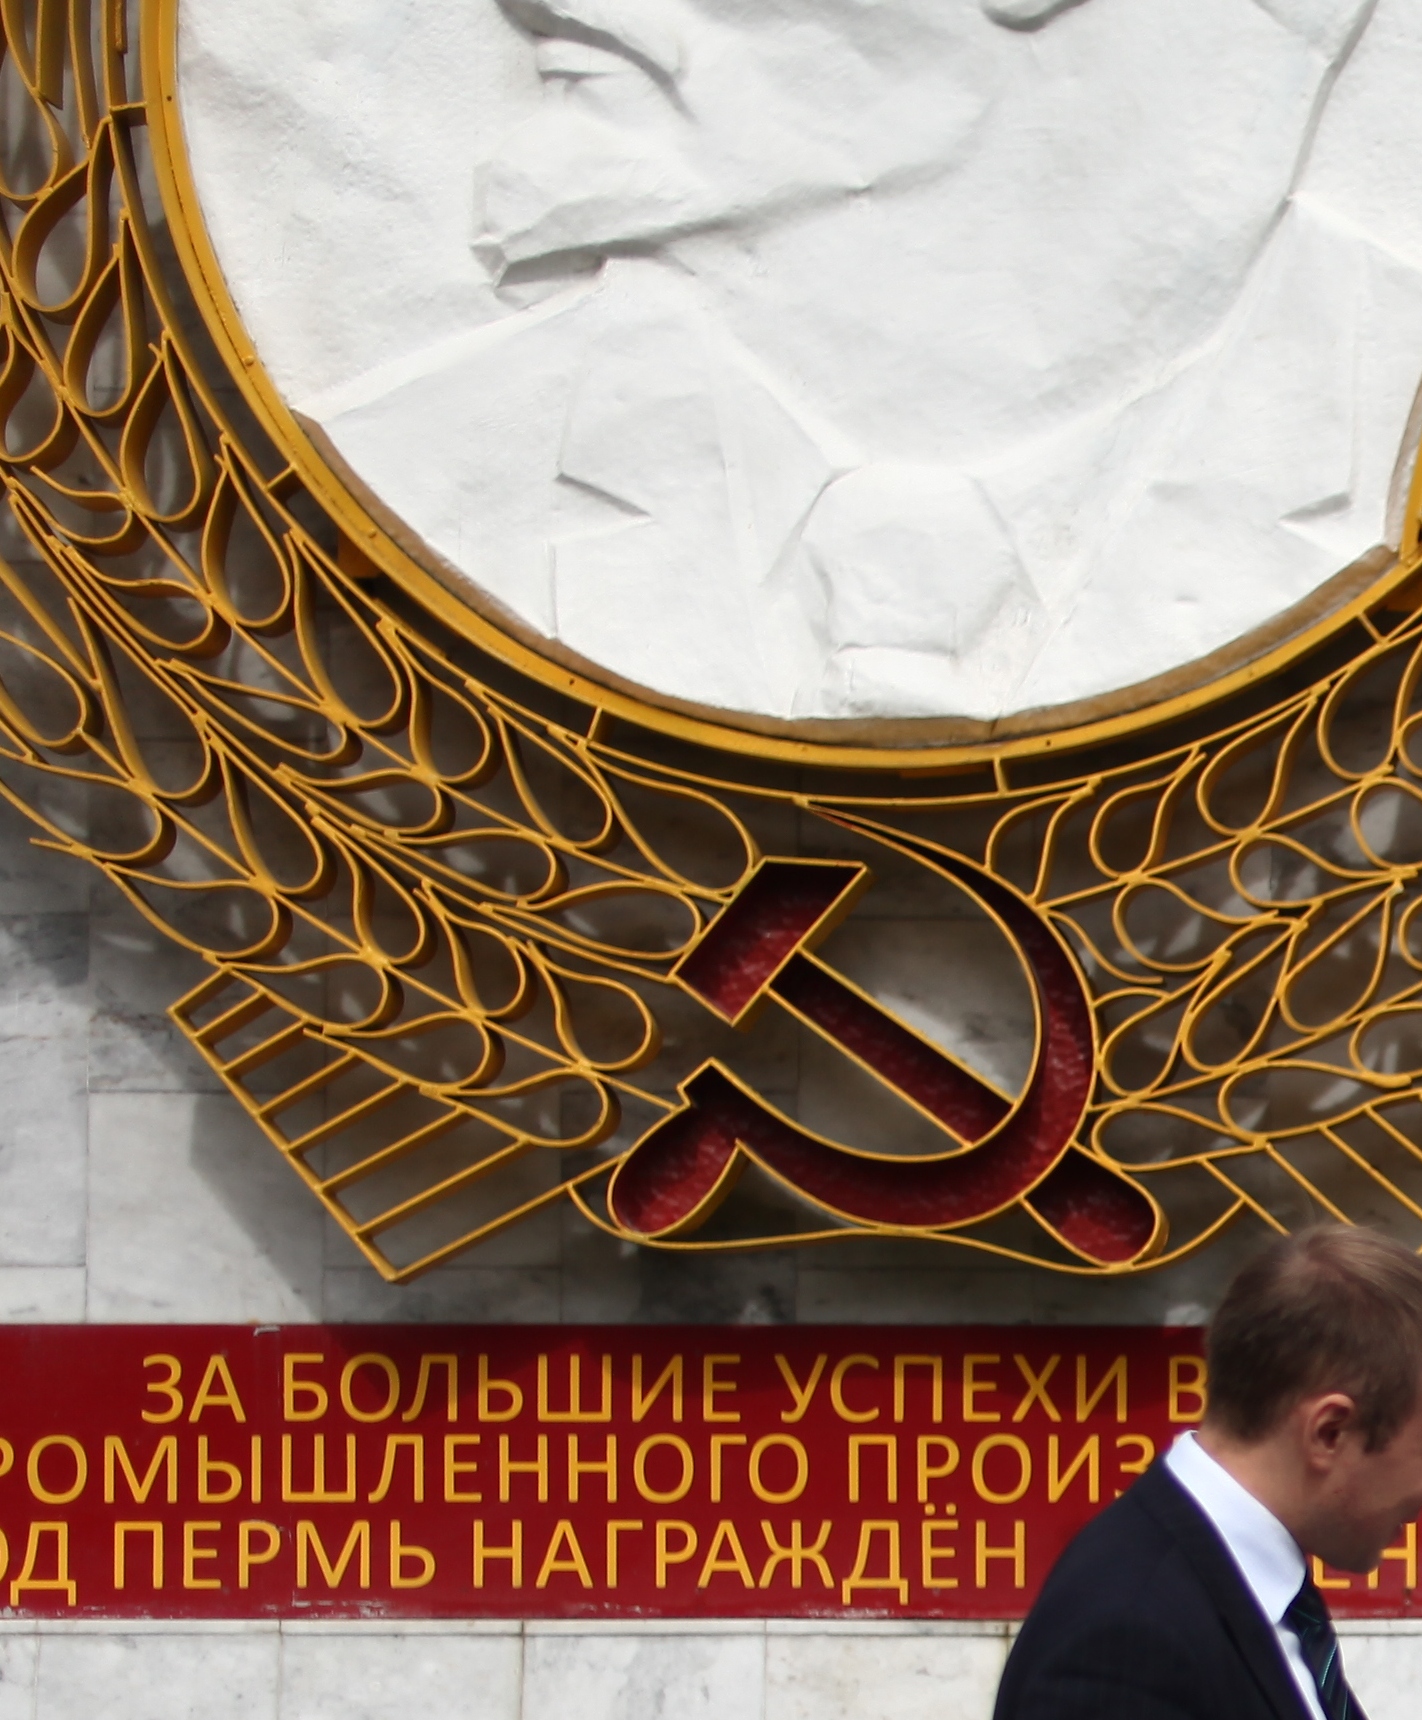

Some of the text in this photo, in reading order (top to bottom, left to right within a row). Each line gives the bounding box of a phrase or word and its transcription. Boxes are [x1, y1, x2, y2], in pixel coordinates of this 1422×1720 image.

[142, 1354, 247, 1423] ЗА
[283, 1354, 741, 1423] БОЛЬШИЕ
[776, 1354, 1128, 1424] УСПЕХИ
[1168, 1354, 1209, 1424] В
[113, 1519, 437, 1590] ПЕРМЬ
[472, 1504, 1026, 1605] НАГРАЖДЁН
